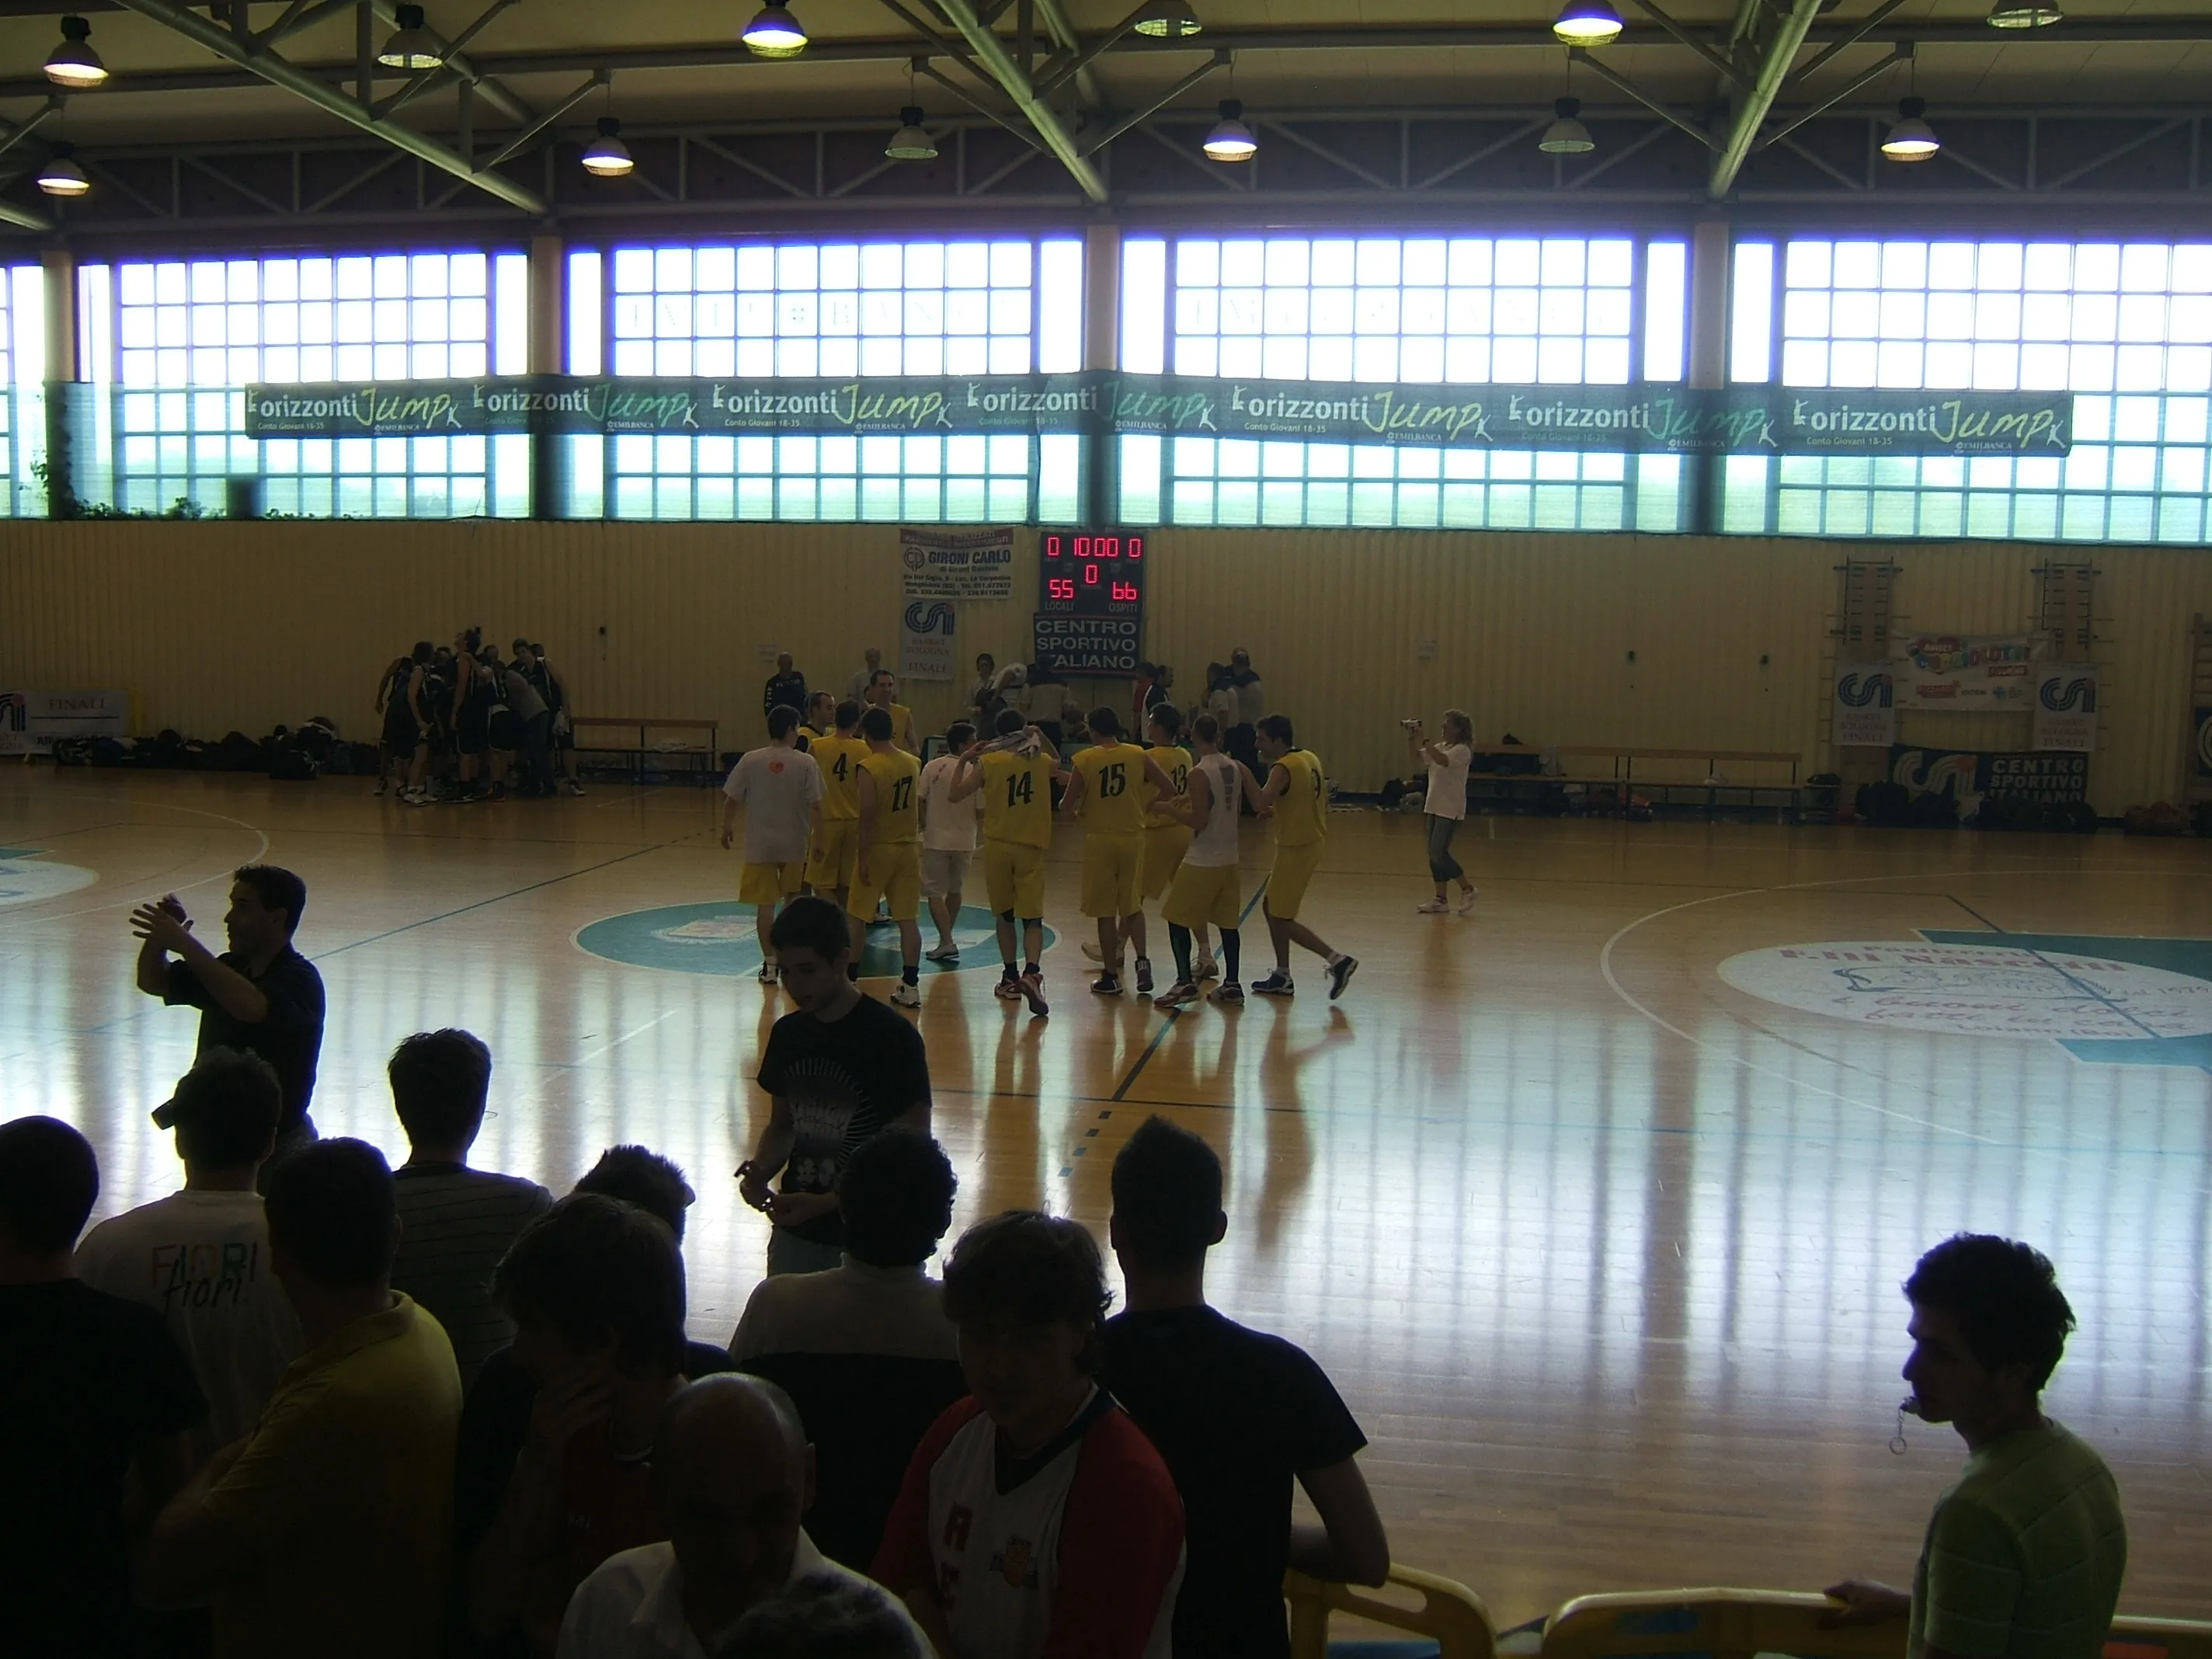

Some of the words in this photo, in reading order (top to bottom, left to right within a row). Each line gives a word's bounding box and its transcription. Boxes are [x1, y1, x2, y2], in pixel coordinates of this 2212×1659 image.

[1244, 422, 1268, 431] Conto
[1807, 436, 1831, 446] Conto
[1833, 436, 1866, 446] Giovani
[1868, 436, 1893, 446] 18-35
[1047, 537, 1061, 557] 0
[1129, 537, 1143, 558] 0
[929, 551, 969, 565] GIRONI
[972, 550, 1012, 564] CARLO
[1085, 564, 1099, 584] 0
[1049, 579, 1075, 599] 55
[1112, 581, 1138, 600] 66
[1035, 620, 1136, 635] CENTRO
[1036, 637, 1136, 652] SPORTIVO
[908, 662, 946, 673] FINALI
[1049, 654, 1136, 669] ALIANO
[48, 698, 106, 711] FINALI
[1842, 732, 1883, 743] FINALI
[832, 752, 848, 782] 4
[1991, 759, 2085, 774] CENTRO
[1098, 763, 1126, 798] 15
[1170, 763, 1188, 797] 13
[1990, 774, 2083, 789] SPORTIVO
[891, 774, 913, 813] 17
[1006, 770, 1035, 809] 14
[152, 1241, 258, 1288] FIORI
